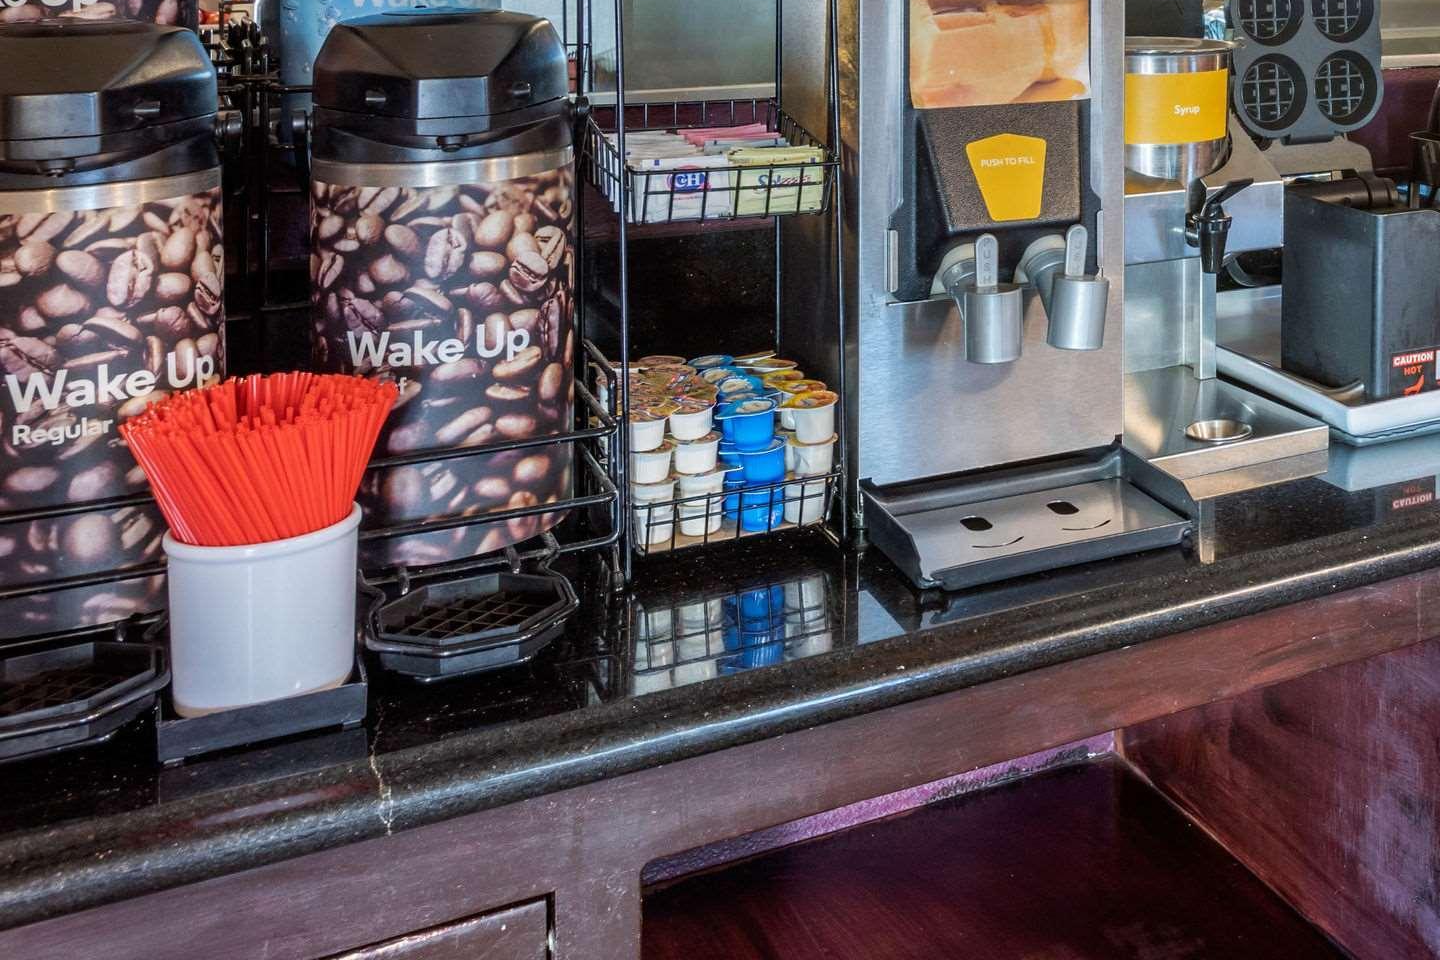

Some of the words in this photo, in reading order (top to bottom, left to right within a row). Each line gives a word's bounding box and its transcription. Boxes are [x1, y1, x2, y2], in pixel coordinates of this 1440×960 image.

[1173, 104, 1201, 117] Syrup
[980, 158, 1004, 168] PUSH
[1005, 157, 1017, 166] TO
[1018, 156, 1036, 165] FILL
[346, 329, 466, 368] Wake
[475, 320, 531, 362] Up
[1393, 350, 1434, 367] CAUTION
[1404, 364, 1424, 377] HOT
[5, 363, 157, 414] Wake
[166, 348, 215, 390] Up
[12, 416, 114, 446] Regular
